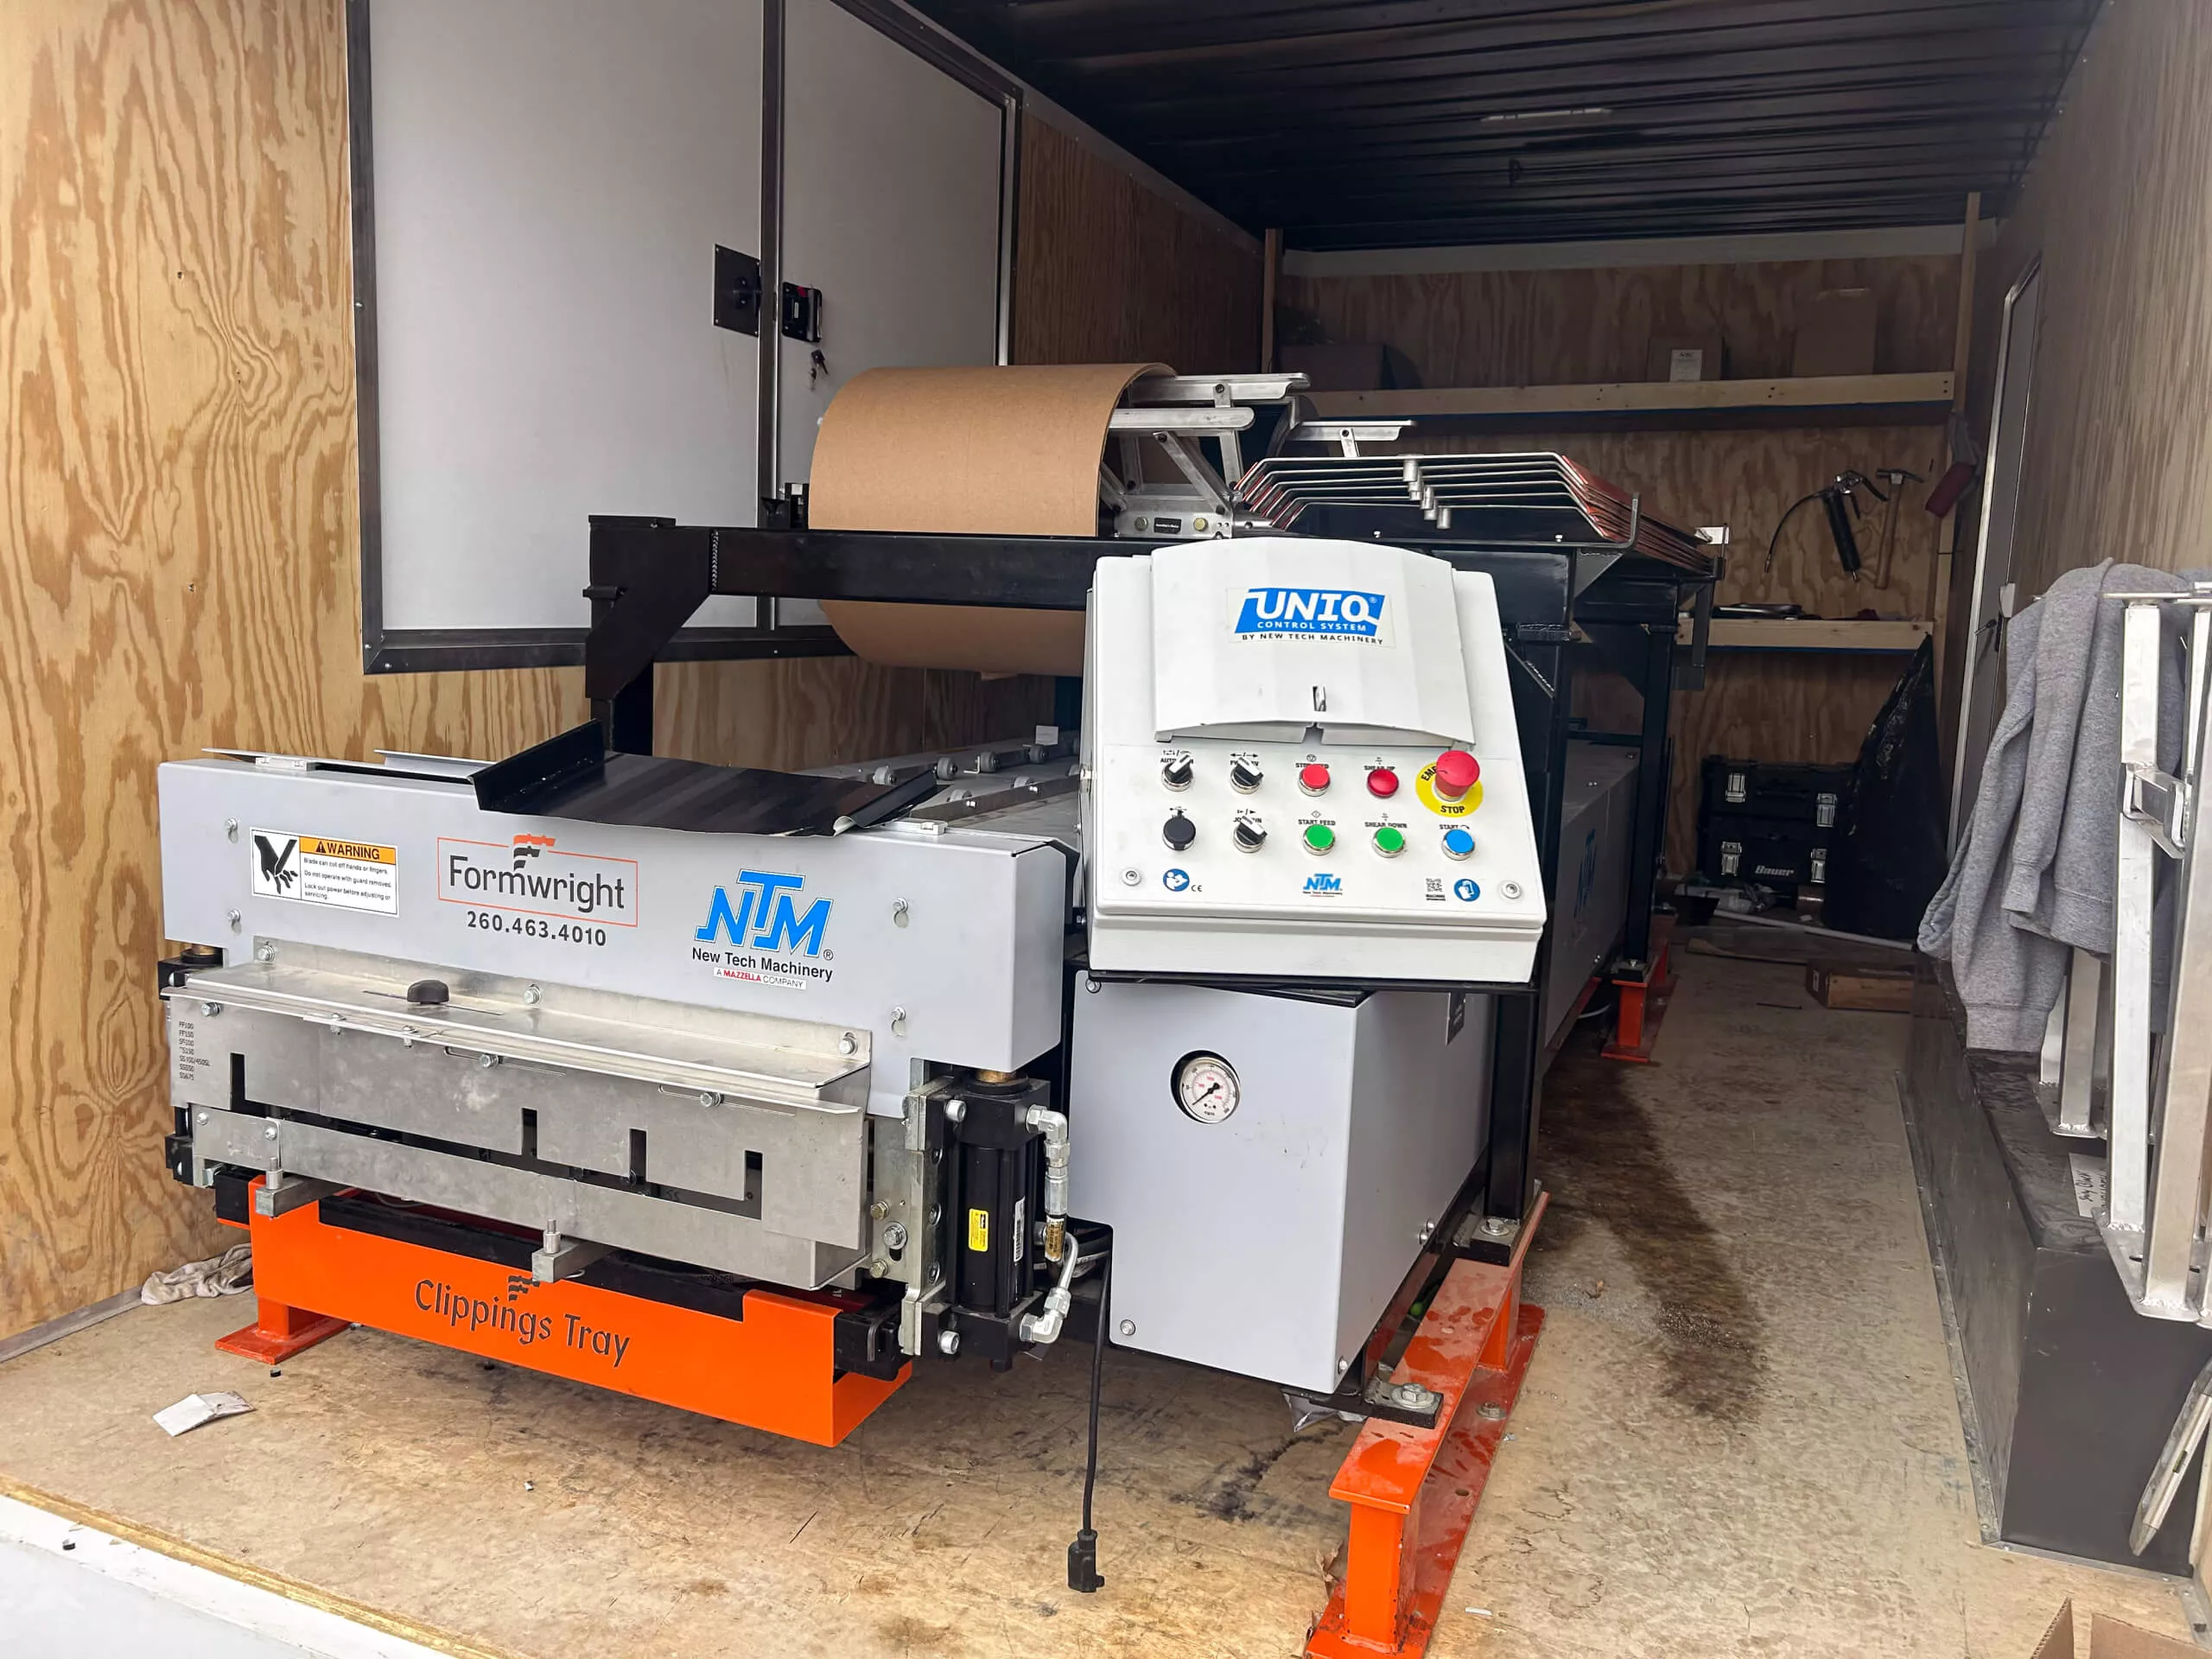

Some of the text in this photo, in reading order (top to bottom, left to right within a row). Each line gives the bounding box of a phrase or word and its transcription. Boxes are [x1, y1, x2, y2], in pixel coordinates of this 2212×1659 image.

[1247, 590, 1380, 626] UNIQ
[1256, 621, 1367, 632] CONTROL SYSTEM
[1320, 634, 1383, 645] MACHINERY
[1440, 804, 1465, 814] STOP
[327, 842, 380, 861] WARNING
[346, 863, 361, 872] hands
[1755, 865, 1795, 876] Bauer
[449, 854, 625, 913] Formwright
[1302, 873, 1342, 891] NTM
[343, 887, 359, 896] before
[360, 891, 384, 900] adjusting
[694, 868, 834, 958] NTM
[467, 910, 607, 947] 260.463.4010
[692, 947, 833, 982] New Tech Machinery
[716, 969, 804, 988] A MAZZELLA COMPANY
[415, 1279, 630, 1368] Clippings Tray
